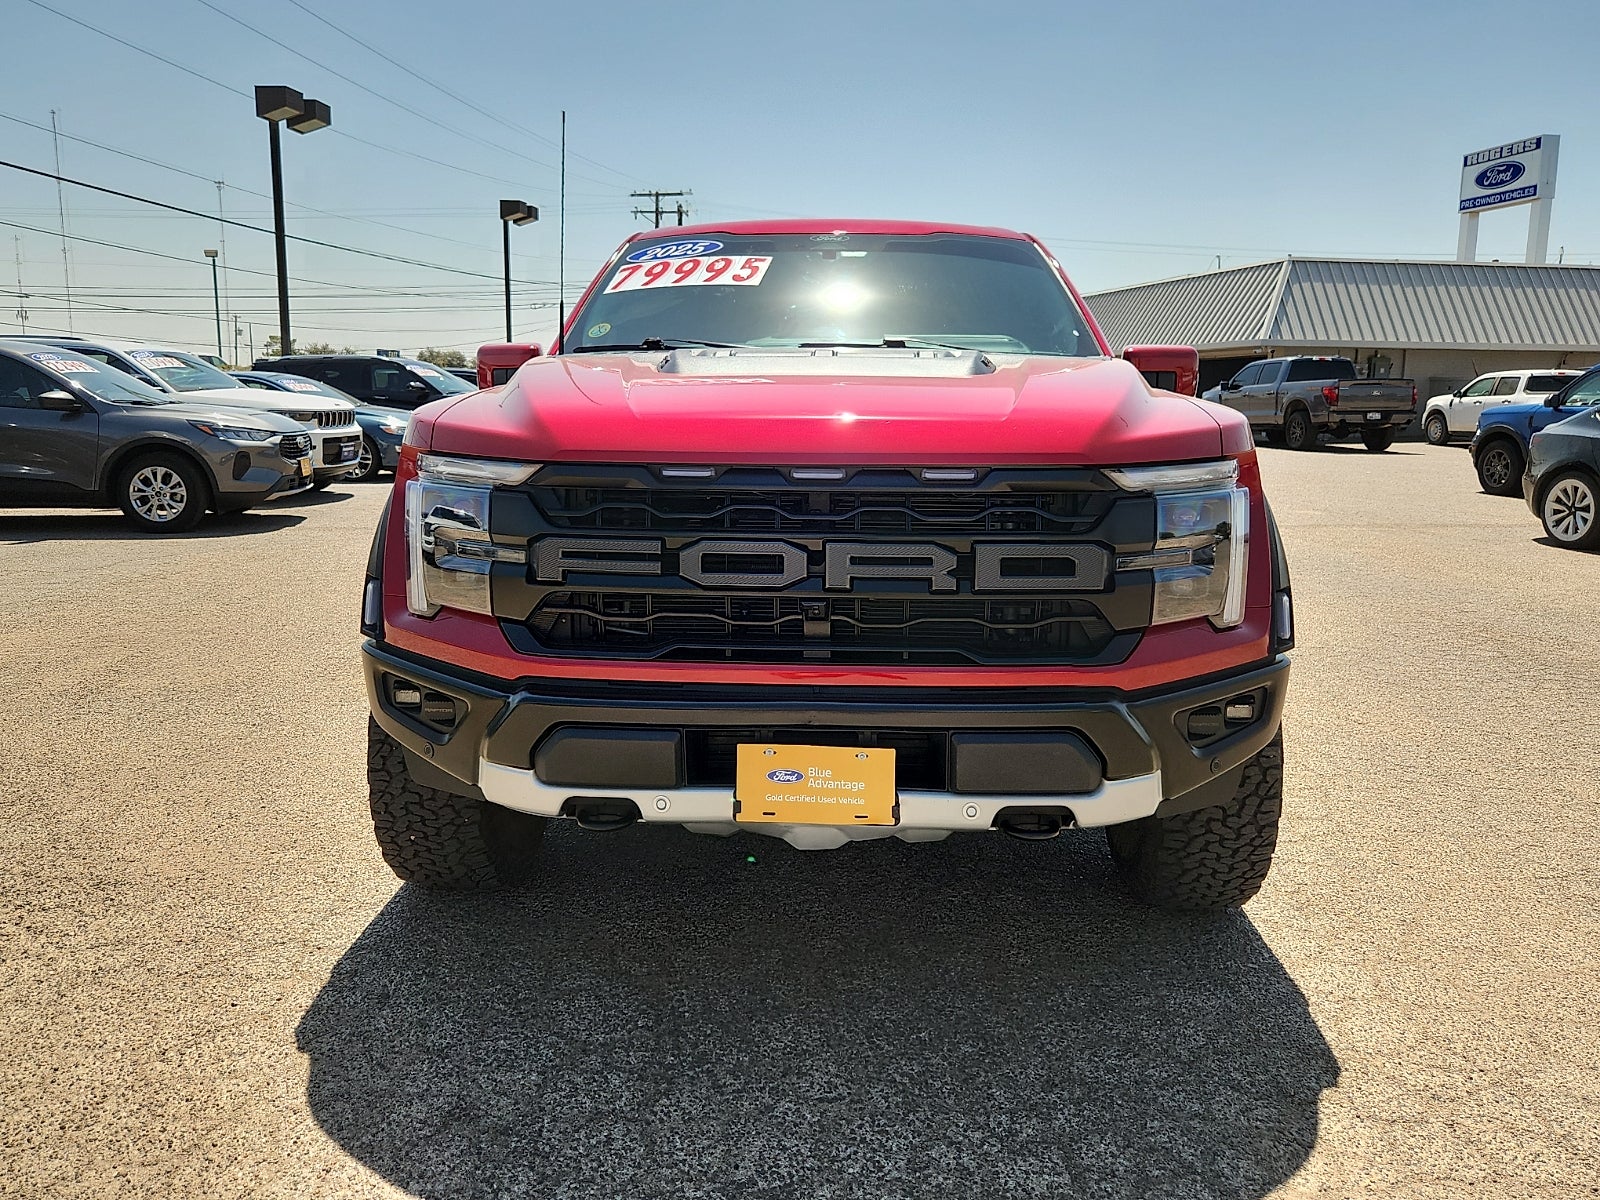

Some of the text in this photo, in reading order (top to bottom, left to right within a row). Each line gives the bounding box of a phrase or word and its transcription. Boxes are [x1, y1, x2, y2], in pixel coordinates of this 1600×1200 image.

[1466, 139, 1537, 166] ROGERS
[1483, 165, 1513, 185] Ford
[1460, 187, 1535, 209] PRE-OWNED VEHICLES
[639, 242, 710, 261] 2025
[610, 257, 768, 291] 79995
[534, 537, 1109, 592] FORD
[773, 770, 798, 782] Ford
[808, 767, 832, 778] Blue
[808, 778, 865, 792] Advantage
[765, 793, 865, 805] Gold Certified Used Vehicle
